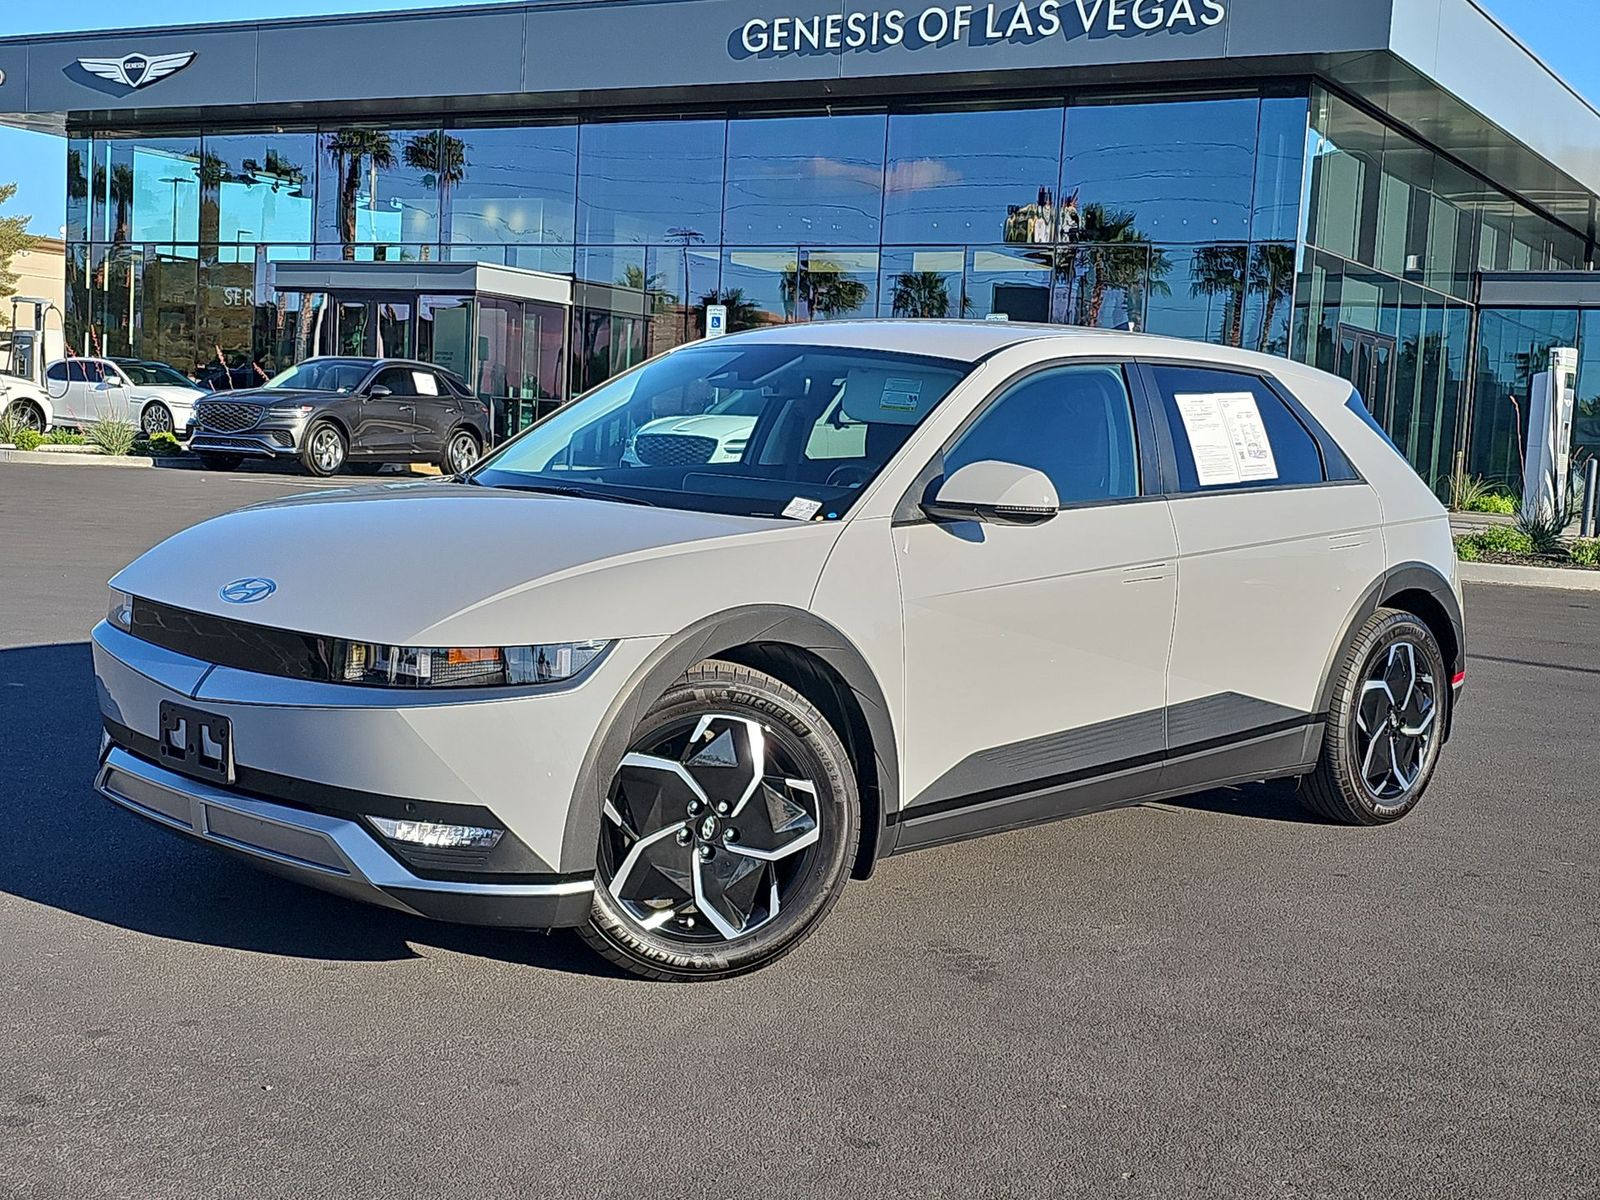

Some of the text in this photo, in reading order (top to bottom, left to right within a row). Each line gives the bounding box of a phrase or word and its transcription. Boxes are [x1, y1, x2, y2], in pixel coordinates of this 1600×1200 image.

[741, 0, 1225, 52] GENESIS OF LAS VEGAS
[732, 692, 809, 737] MICHELIN
[612, 926, 690, 967] MICHELIN
